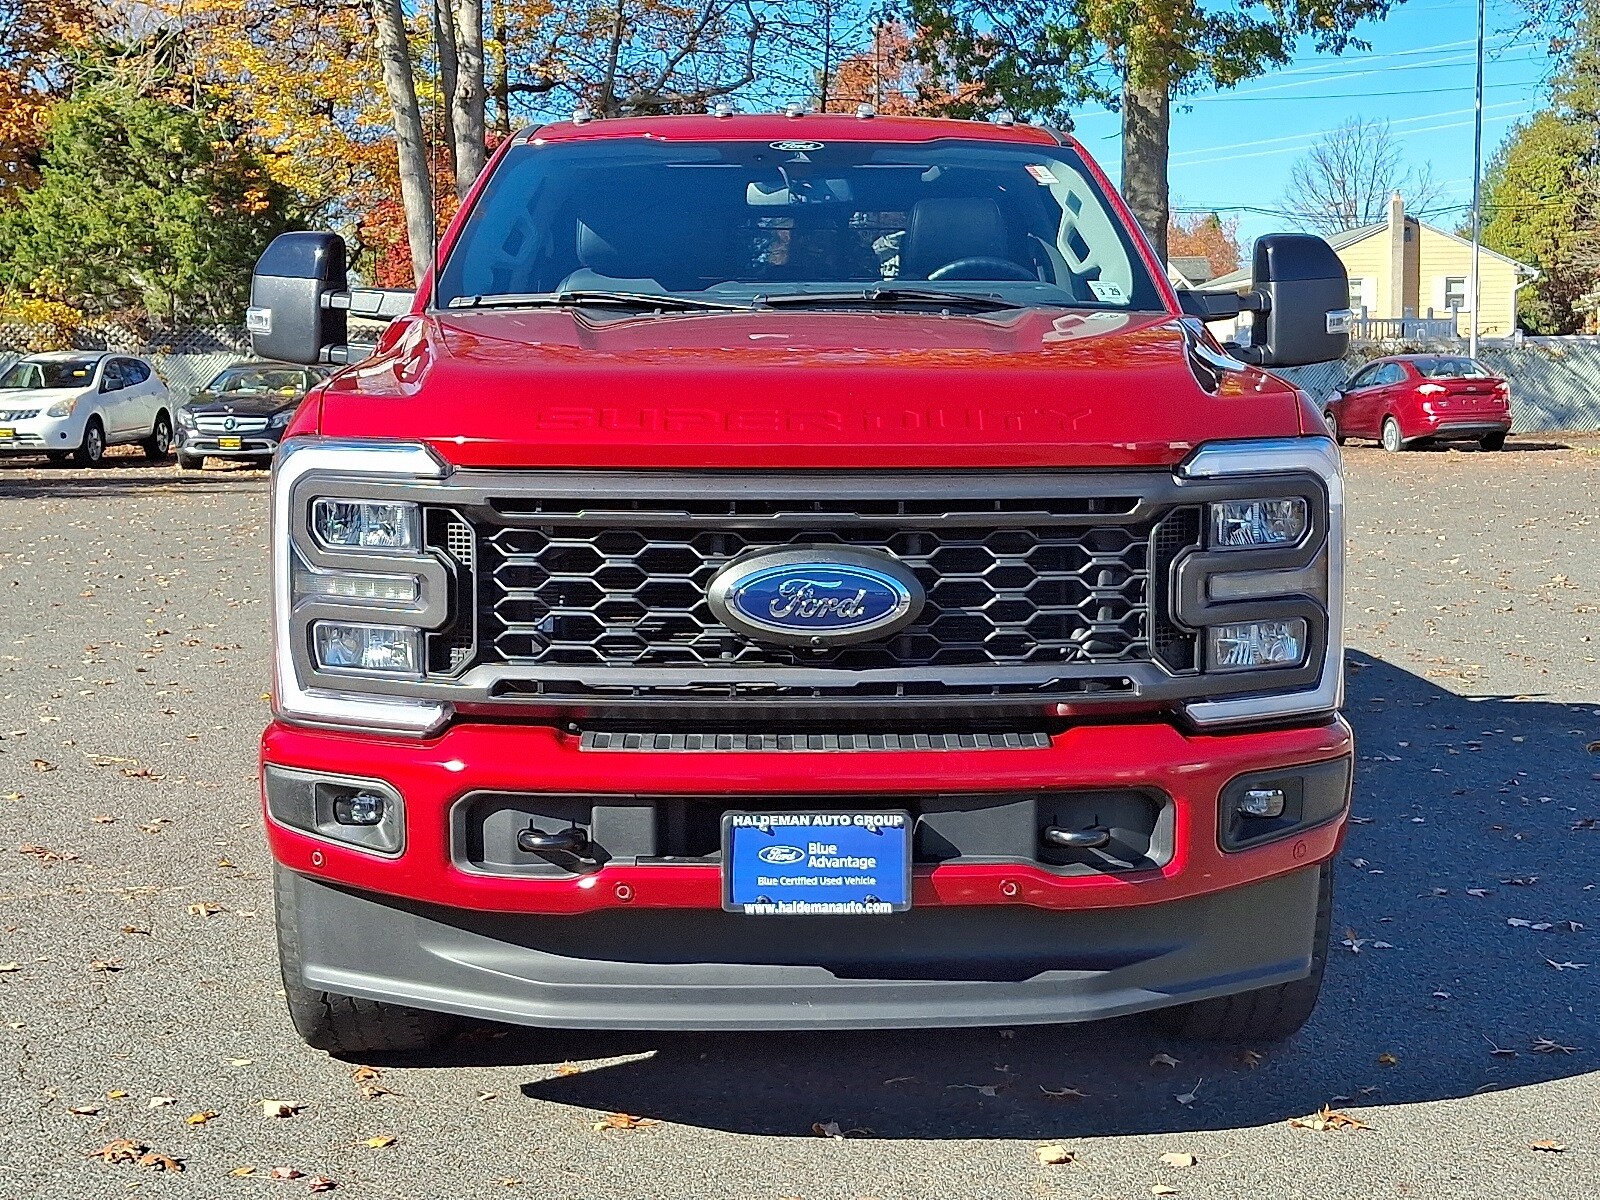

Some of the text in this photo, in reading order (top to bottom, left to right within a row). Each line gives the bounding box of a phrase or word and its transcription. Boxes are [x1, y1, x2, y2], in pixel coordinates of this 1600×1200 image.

[536, 407, 1092, 432] SUPER DUTY
[769, 578, 866, 619] Ford
[732, 815, 904, 827] HALDEMAN AUTO GROUP
[767, 848, 796, 861] Ford
[808, 842, 837, 855] Blue
[808, 855, 876, 869] Advantage
[757, 876, 876, 886] Blue Certified Used Vehicle
[744, 901, 892, 915] www.haldemanauto.com
